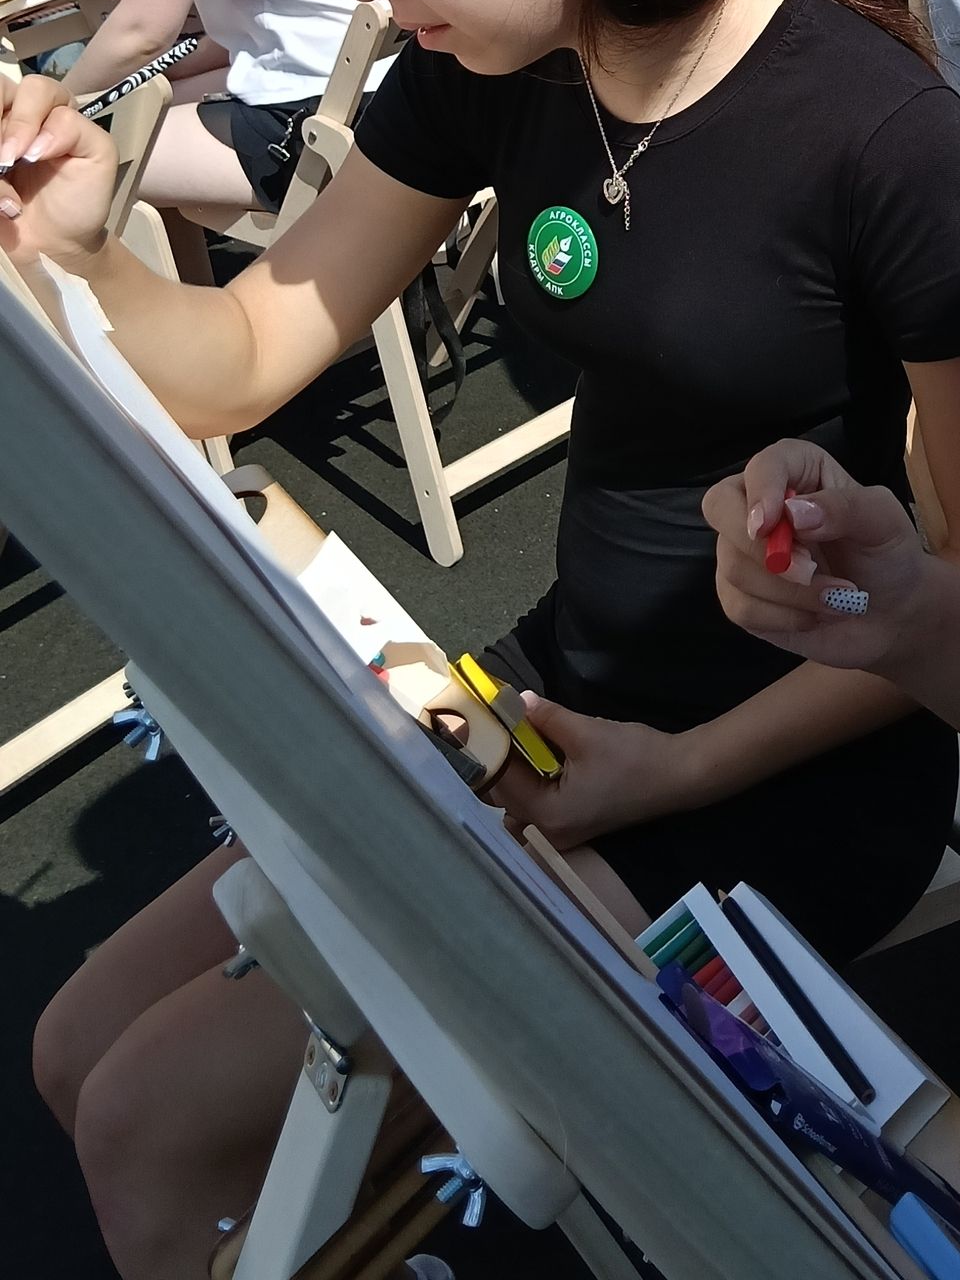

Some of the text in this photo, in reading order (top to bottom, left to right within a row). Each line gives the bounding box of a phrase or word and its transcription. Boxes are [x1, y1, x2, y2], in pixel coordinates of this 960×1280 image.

[549, 211, 592, 268] АГРОКЛАССЫ
[528, 244, 564, 296] КАДРЫ АПК
